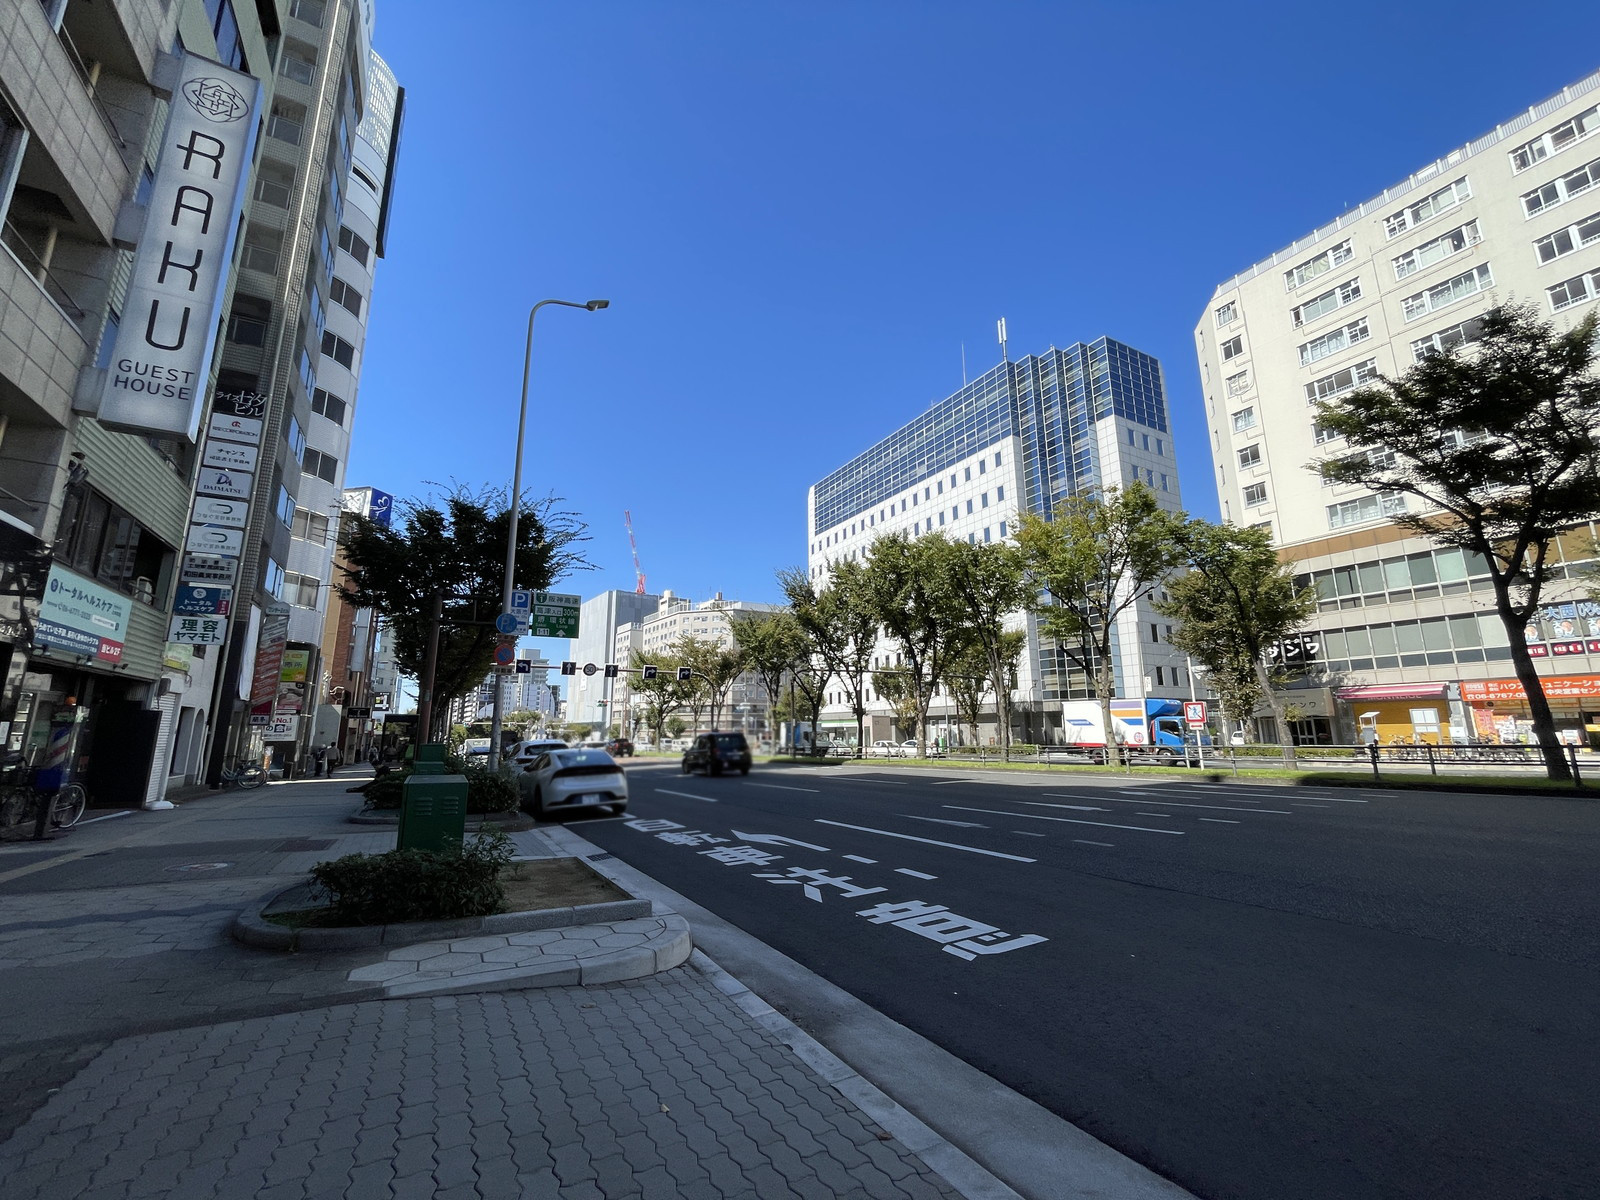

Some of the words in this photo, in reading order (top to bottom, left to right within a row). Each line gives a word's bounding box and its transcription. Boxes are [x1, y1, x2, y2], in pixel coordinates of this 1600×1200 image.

[145, 130, 225, 351] RAKU
[118, 359, 195, 384] GUEST
[114, 374, 192, 400] HOUSE
[218, 448, 245, 457] チャンス
[58, 582, 113, 612] トータルヘルスケア
[514, 593, 526, 606] P
[548, 595, 579, 604] 阪神高速
[181, 619, 219, 632] 理容
[174, 631, 220, 642] ヤマモト
[1267, 643, 1319, 658] サンワ
[623, 818, 1049, 961] 自転車注意
